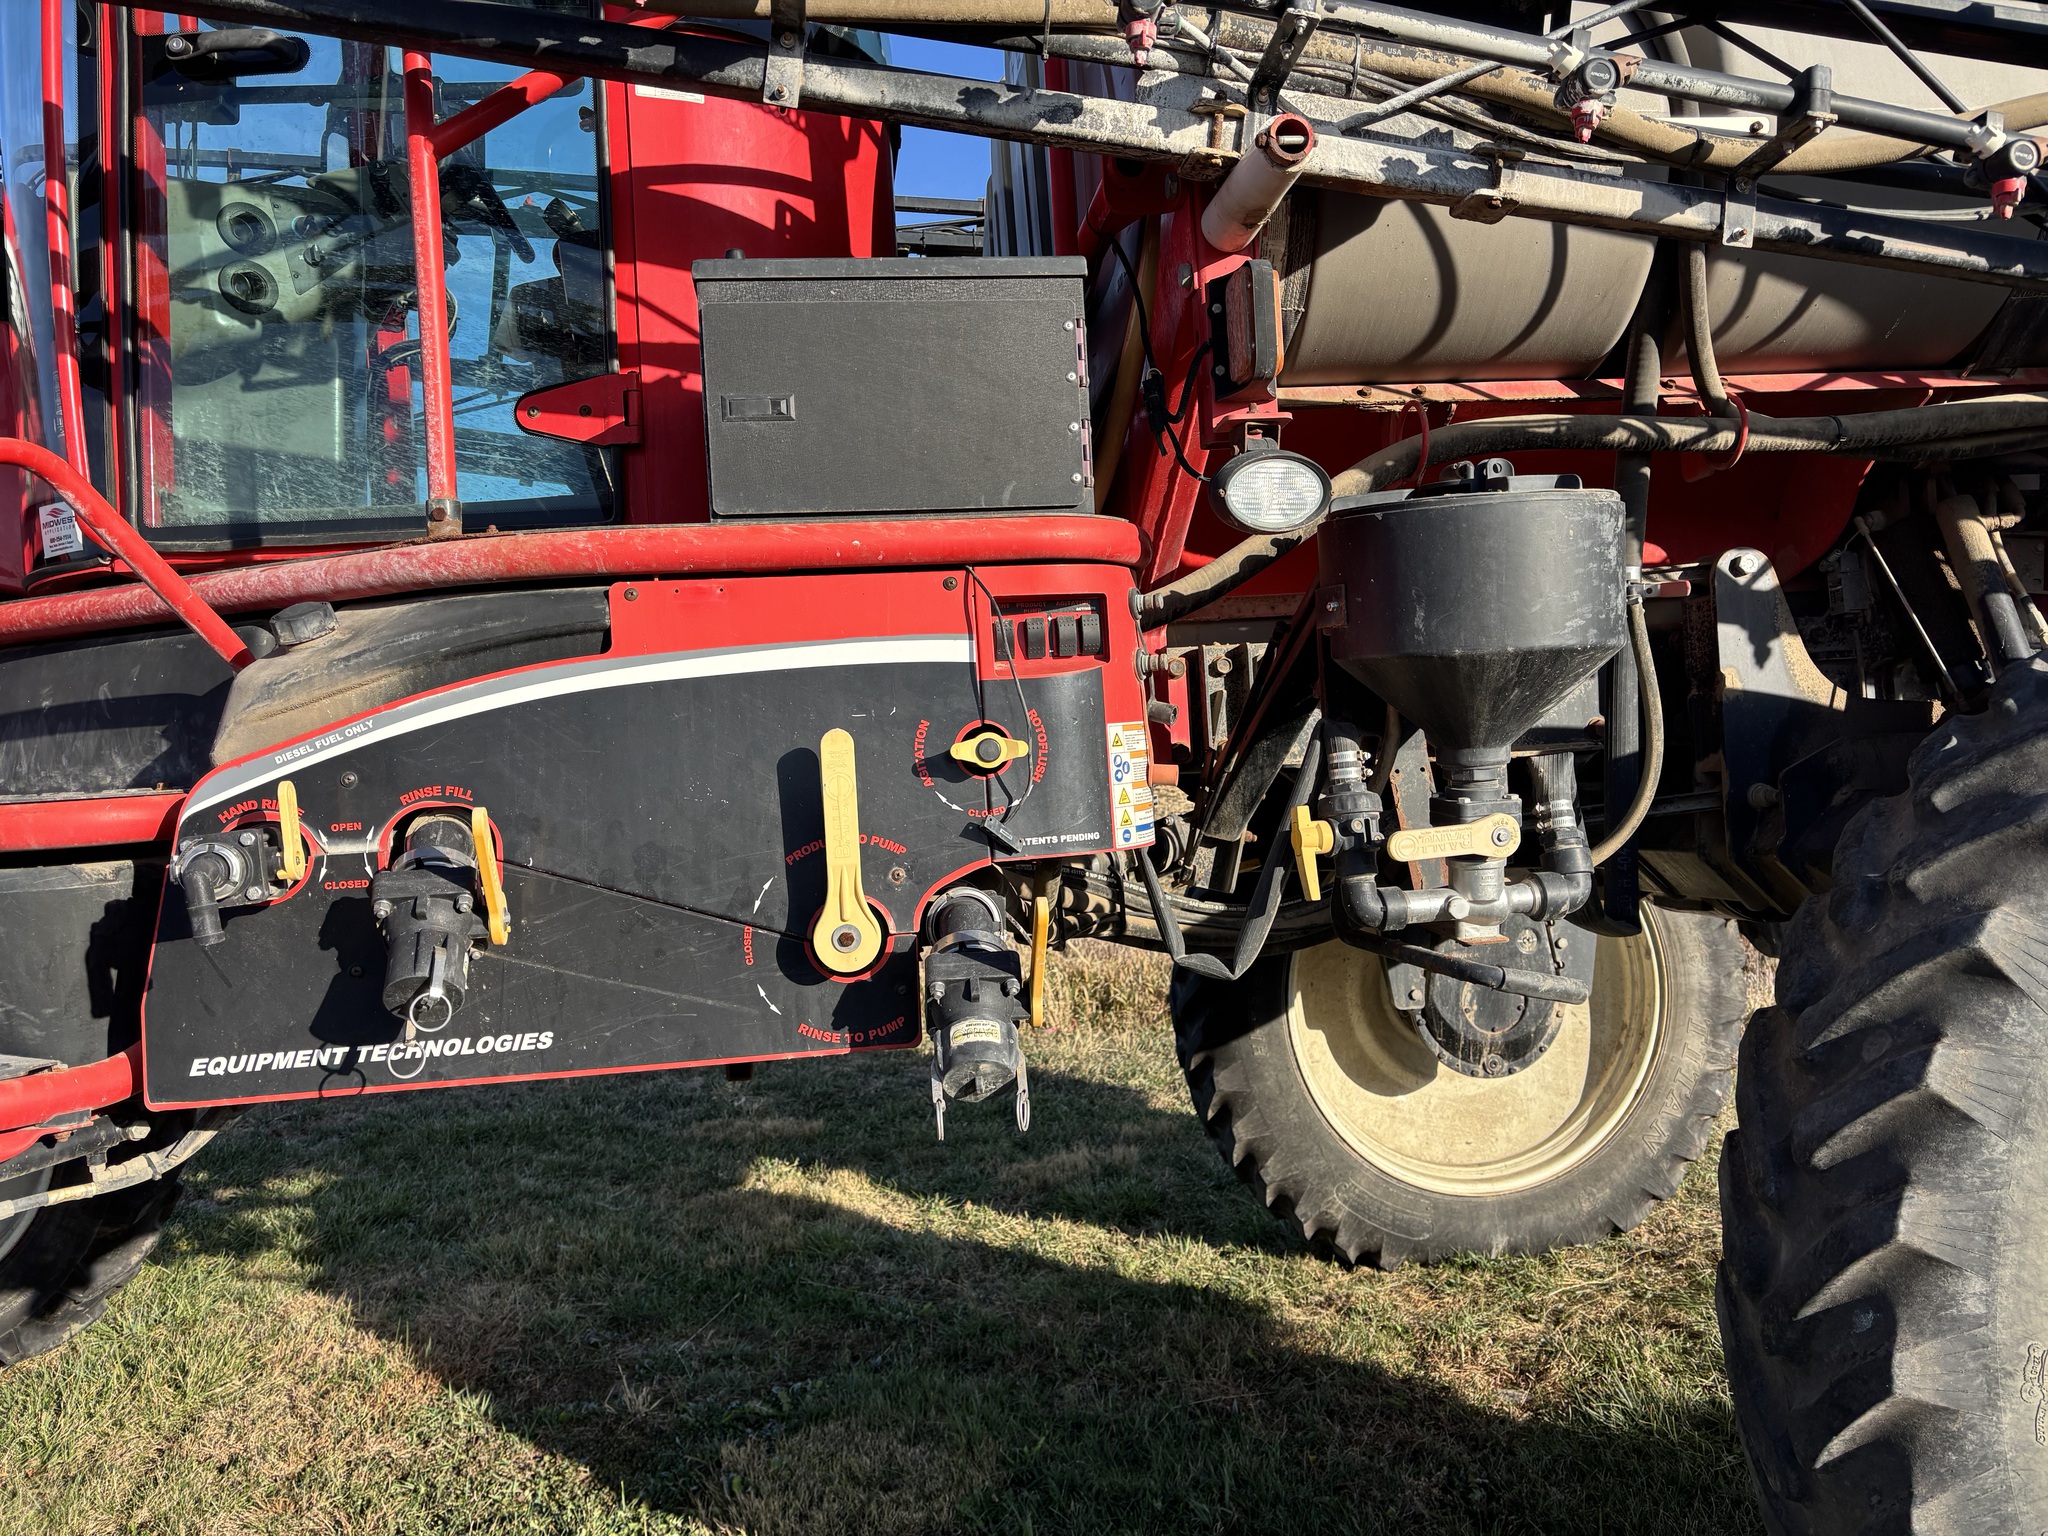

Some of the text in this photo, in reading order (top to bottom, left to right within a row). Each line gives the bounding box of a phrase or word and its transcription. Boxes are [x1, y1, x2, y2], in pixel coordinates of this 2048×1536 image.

[1352, 42, 1372, 51] MDE
[1387, 48, 1402, 56] USA
[274, 720, 374, 765] DIESEL FUEL ONLY
[914, 719, 935, 788] AGITATION
[1028, 708, 1048, 783] ROTOFLUSH
[400, 784, 474, 806] RINSE FILL
[218, 798, 304, 823] HAND RIE
[330, 822, 362, 832] OPEN
[1022, 832, 1100, 846] ATENTS PENDING
[786, 834, 907, 866] PRODU O PUMP
[324, 879, 370, 890] CLOSED
[743, 926, 754, 966] CLOSED
[798, 1016, 906, 1044] RINSE TO PUMP
[188, 1031, 554, 1077] EQUIPMENT TECHNOLOGIES
